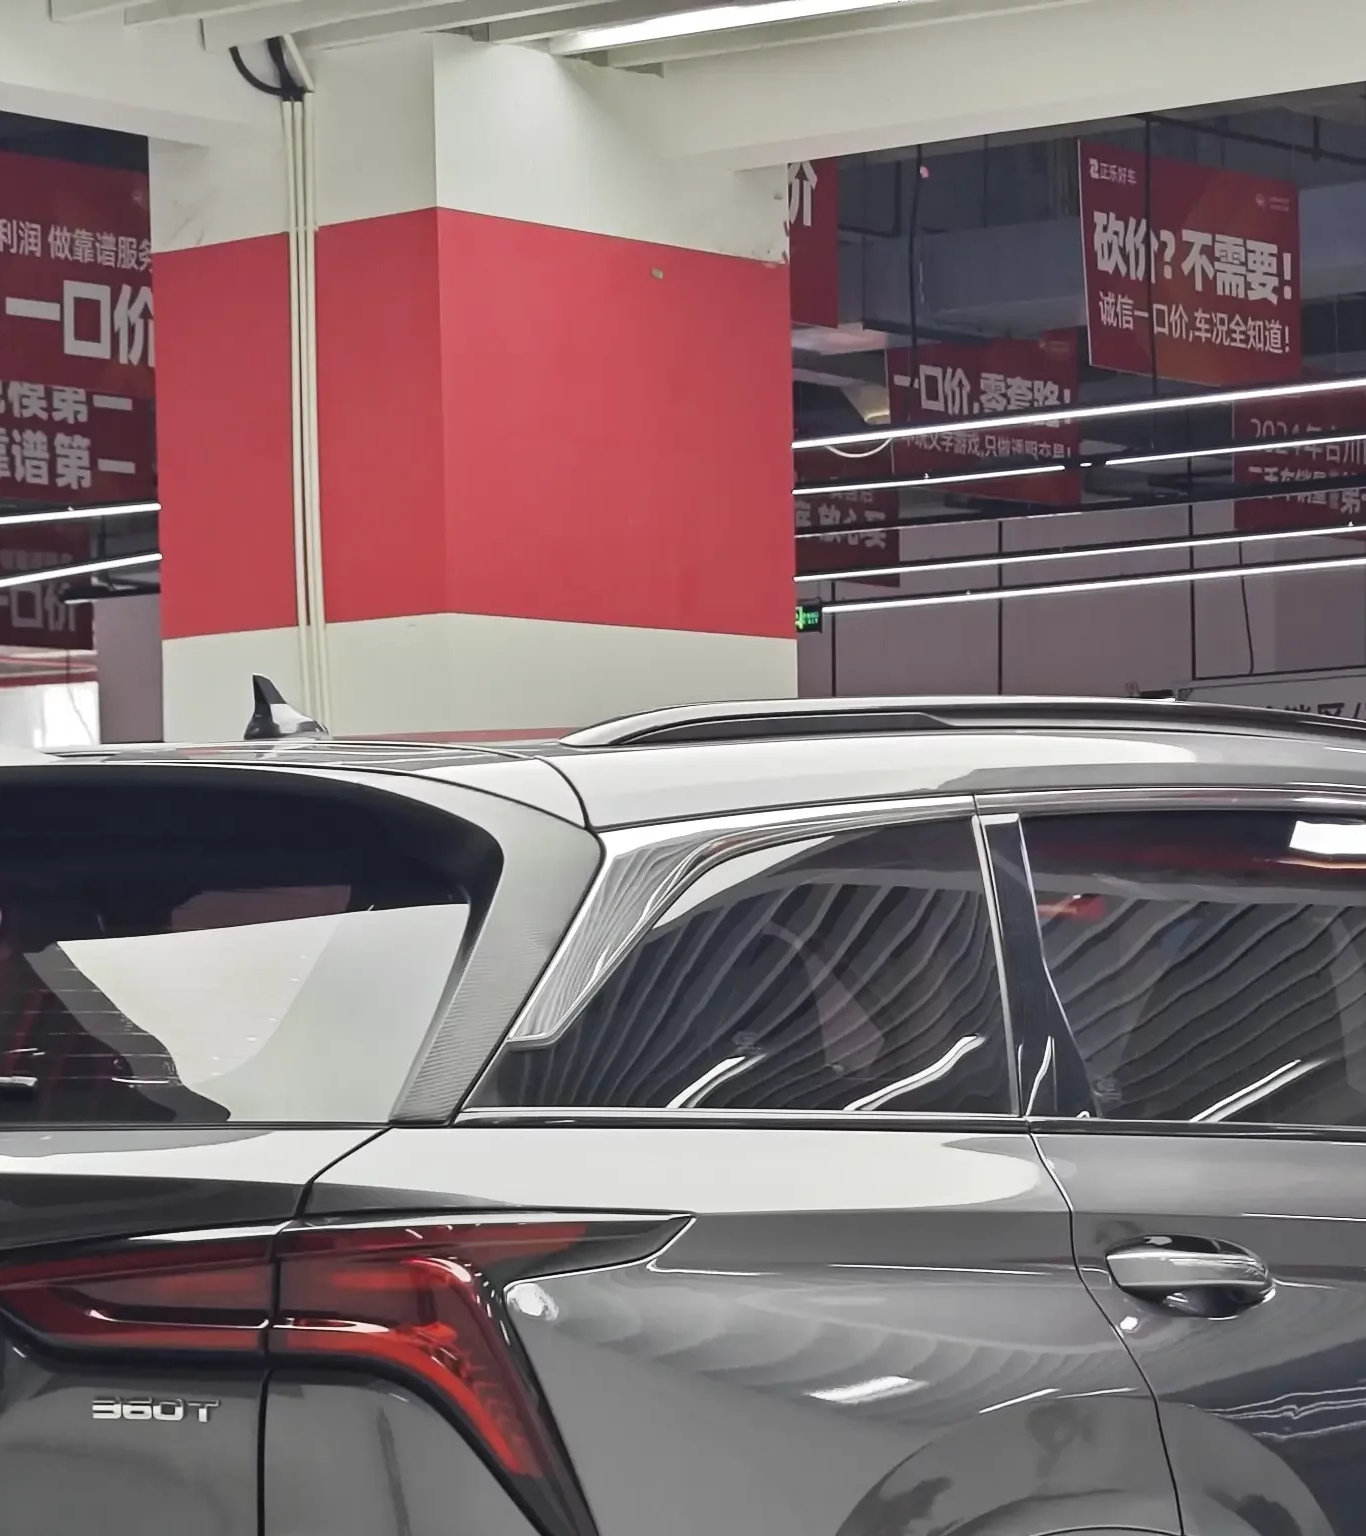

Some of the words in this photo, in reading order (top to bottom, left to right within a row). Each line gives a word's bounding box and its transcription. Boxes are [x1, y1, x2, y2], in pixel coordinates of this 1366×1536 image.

[1099, 162, 1137, 185] 正乐好车
[47, 223, 154, 273] 做靠谱服务
[5, 279, 155, 368] 一口价
[1099, 290, 1290, 354] 诚信一口价,车况全知道!
[92, 1398, 220, 1422] 360T
